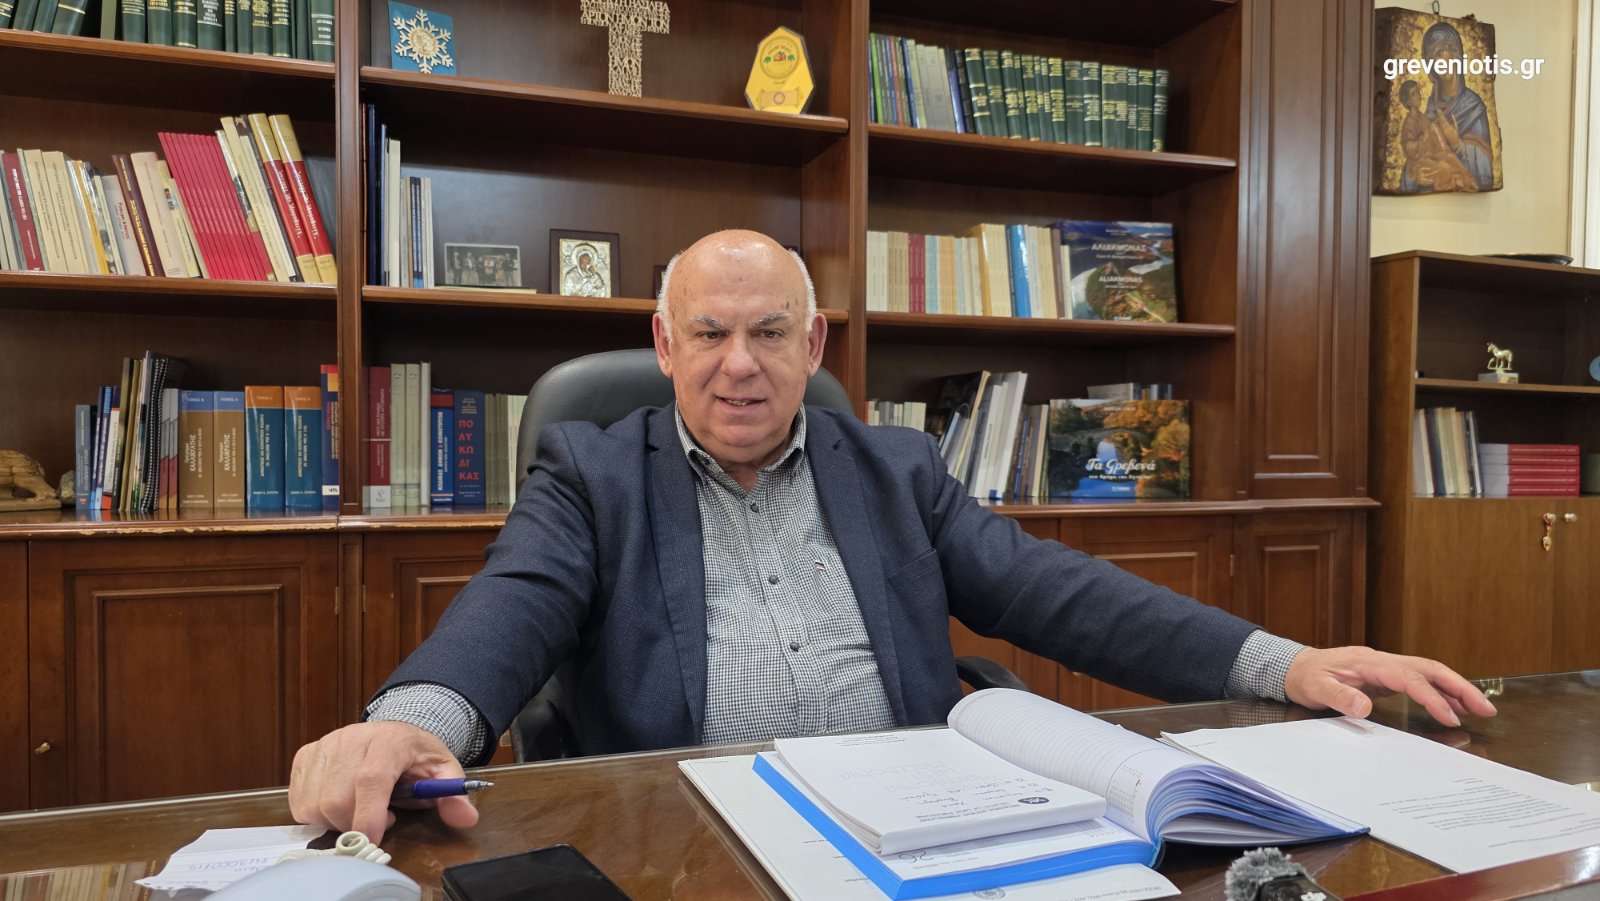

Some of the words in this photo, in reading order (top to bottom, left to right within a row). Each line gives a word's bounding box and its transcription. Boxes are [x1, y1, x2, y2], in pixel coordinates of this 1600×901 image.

[1091, 243, 1147, 252] ΑΛΙΑΚΜΟΝΑΣ
[459, 419, 474, 428] ΠΟ
[459, 432, 472, 441] ΛΥ
[459, 445, 475, 454] ΚΩ
[459, 459, 470, 467] ΔΙ
[1085, 458, 1104, 472] Τα
[459, 471, 480, 481] ΚΑΣ
